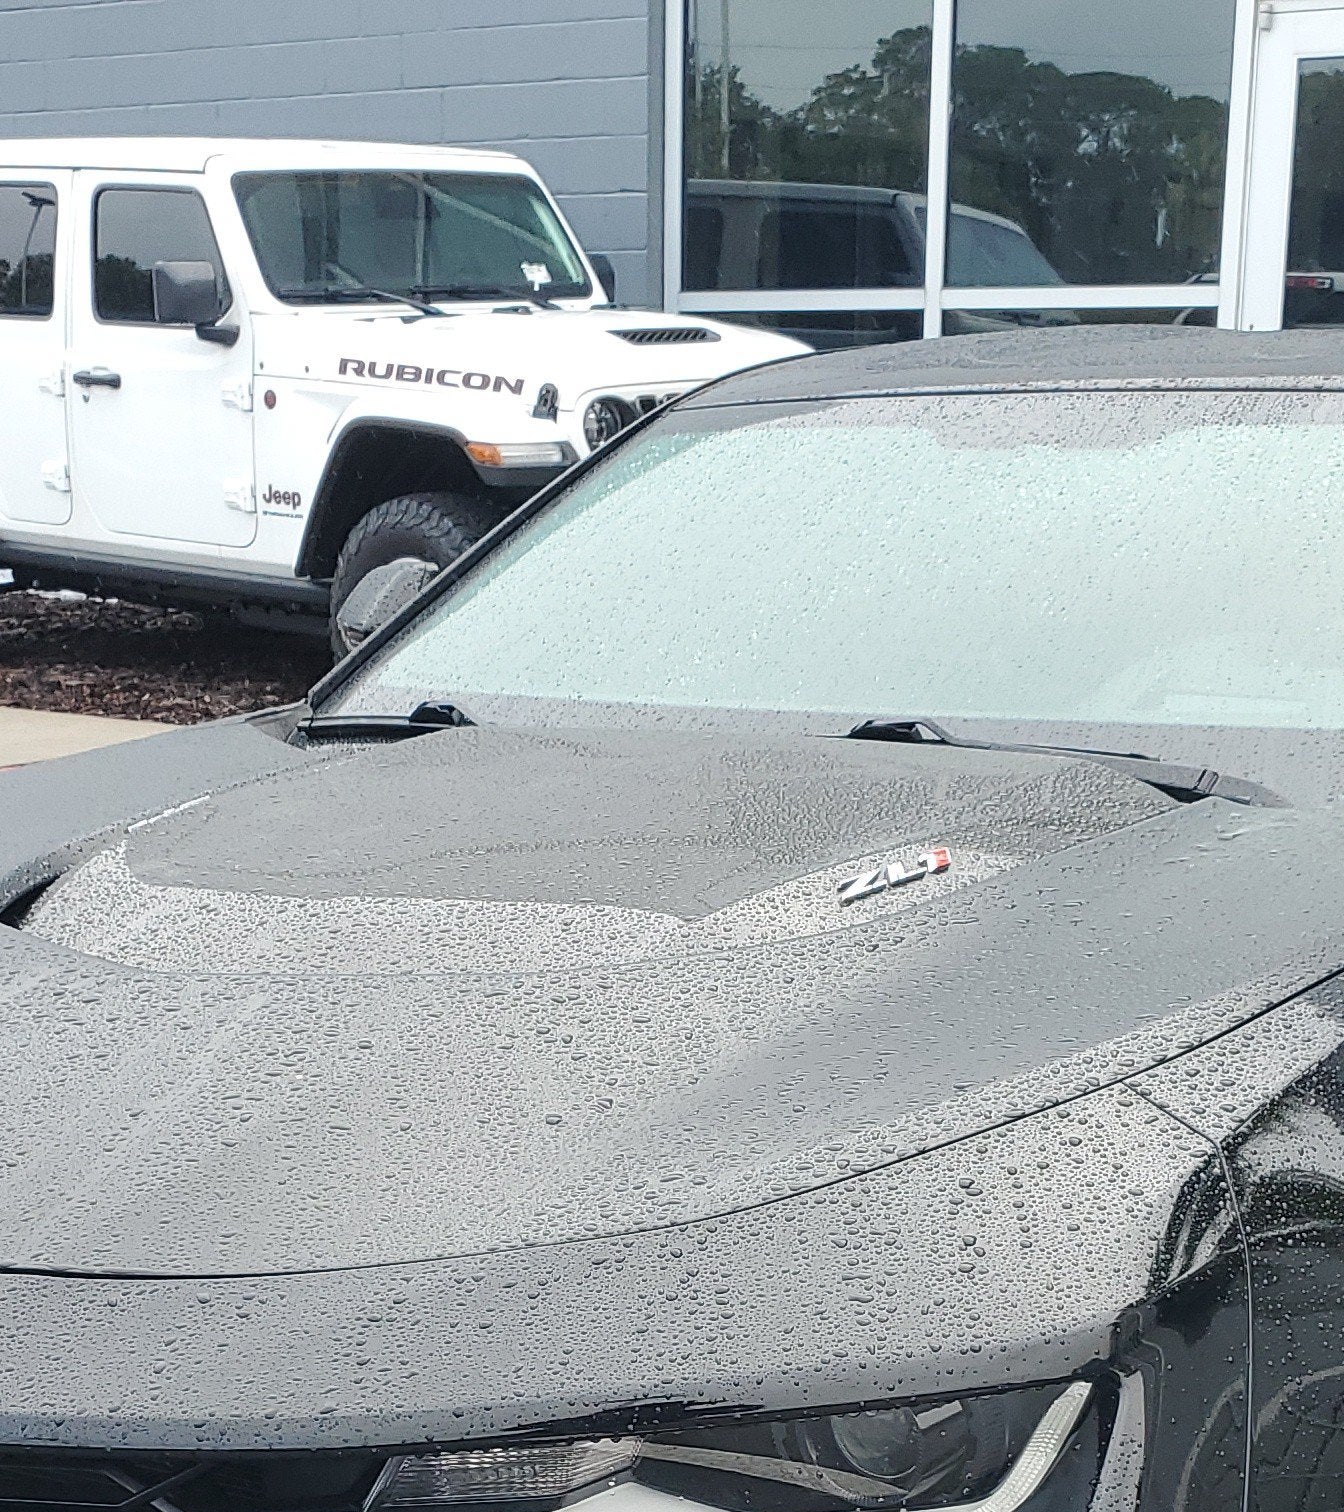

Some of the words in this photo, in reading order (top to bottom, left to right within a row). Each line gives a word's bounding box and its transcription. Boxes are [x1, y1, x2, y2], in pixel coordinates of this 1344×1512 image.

[338, 358, 525, 395] RUBICON
[262, 484, 301, 510] Jeep
[837, 847, 951, 905] ZL1
